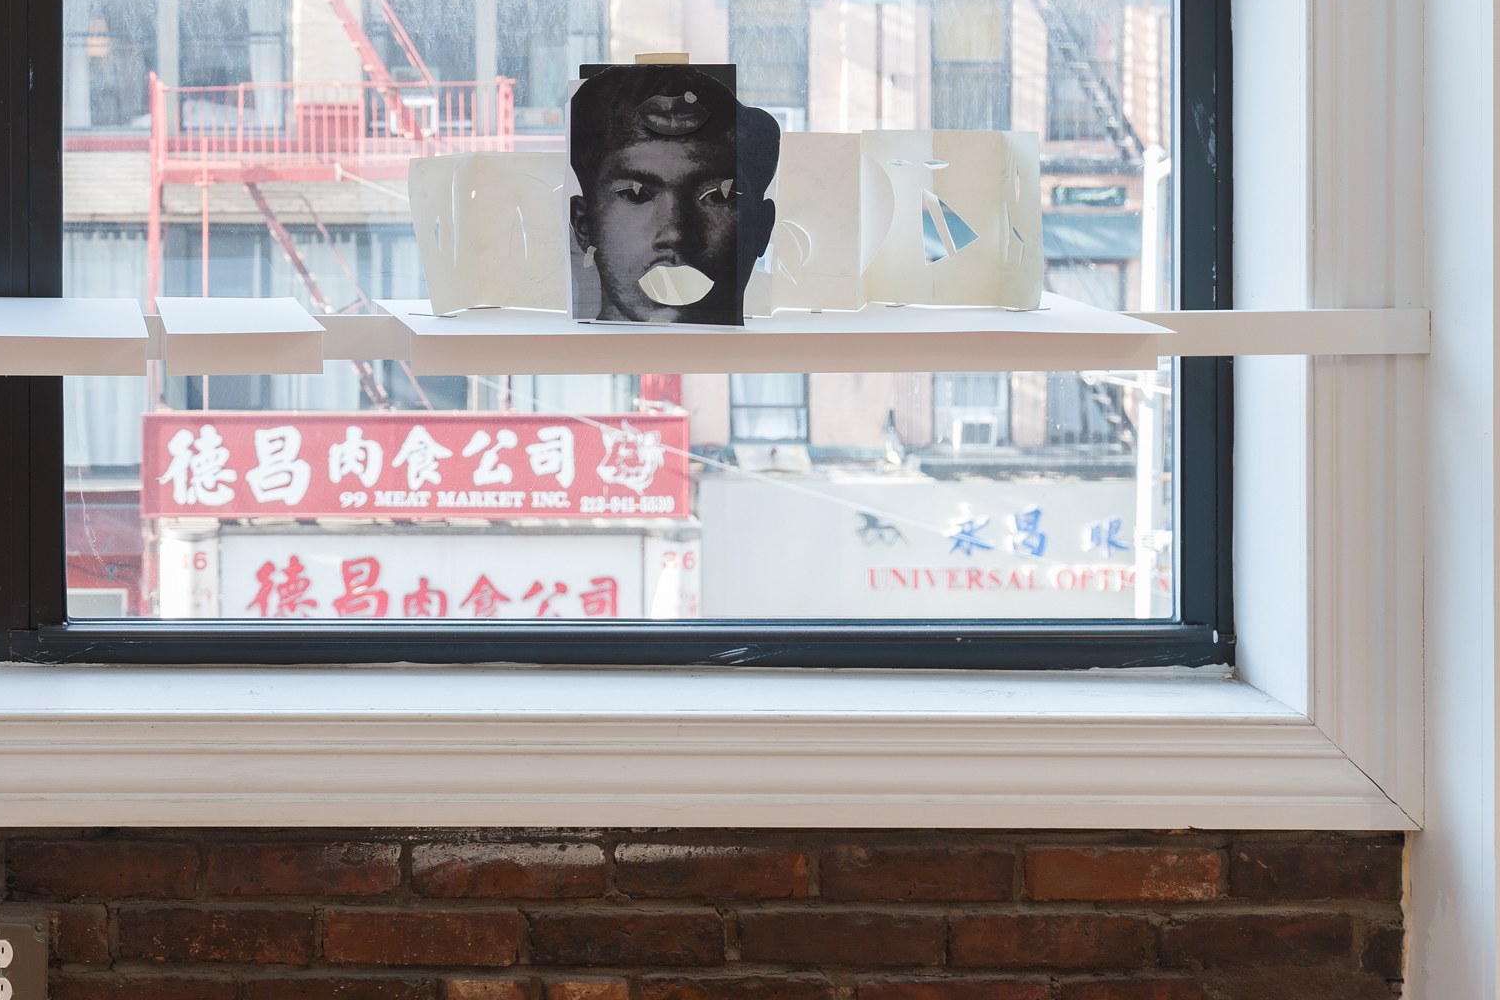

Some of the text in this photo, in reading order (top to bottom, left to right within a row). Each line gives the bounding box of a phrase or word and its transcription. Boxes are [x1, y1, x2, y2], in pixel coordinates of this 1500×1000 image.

[156, 424, 575, 506] 德昌肉食公司
[339, 490, 570, 508] 99 MEAT MARKET INC.
[943, 503, 1171, 558] 永昌眼
[246, 555, 619, 617] 德昌肉食公司
[867, 567, 1171, 592] UNIVERSAL OPTI
